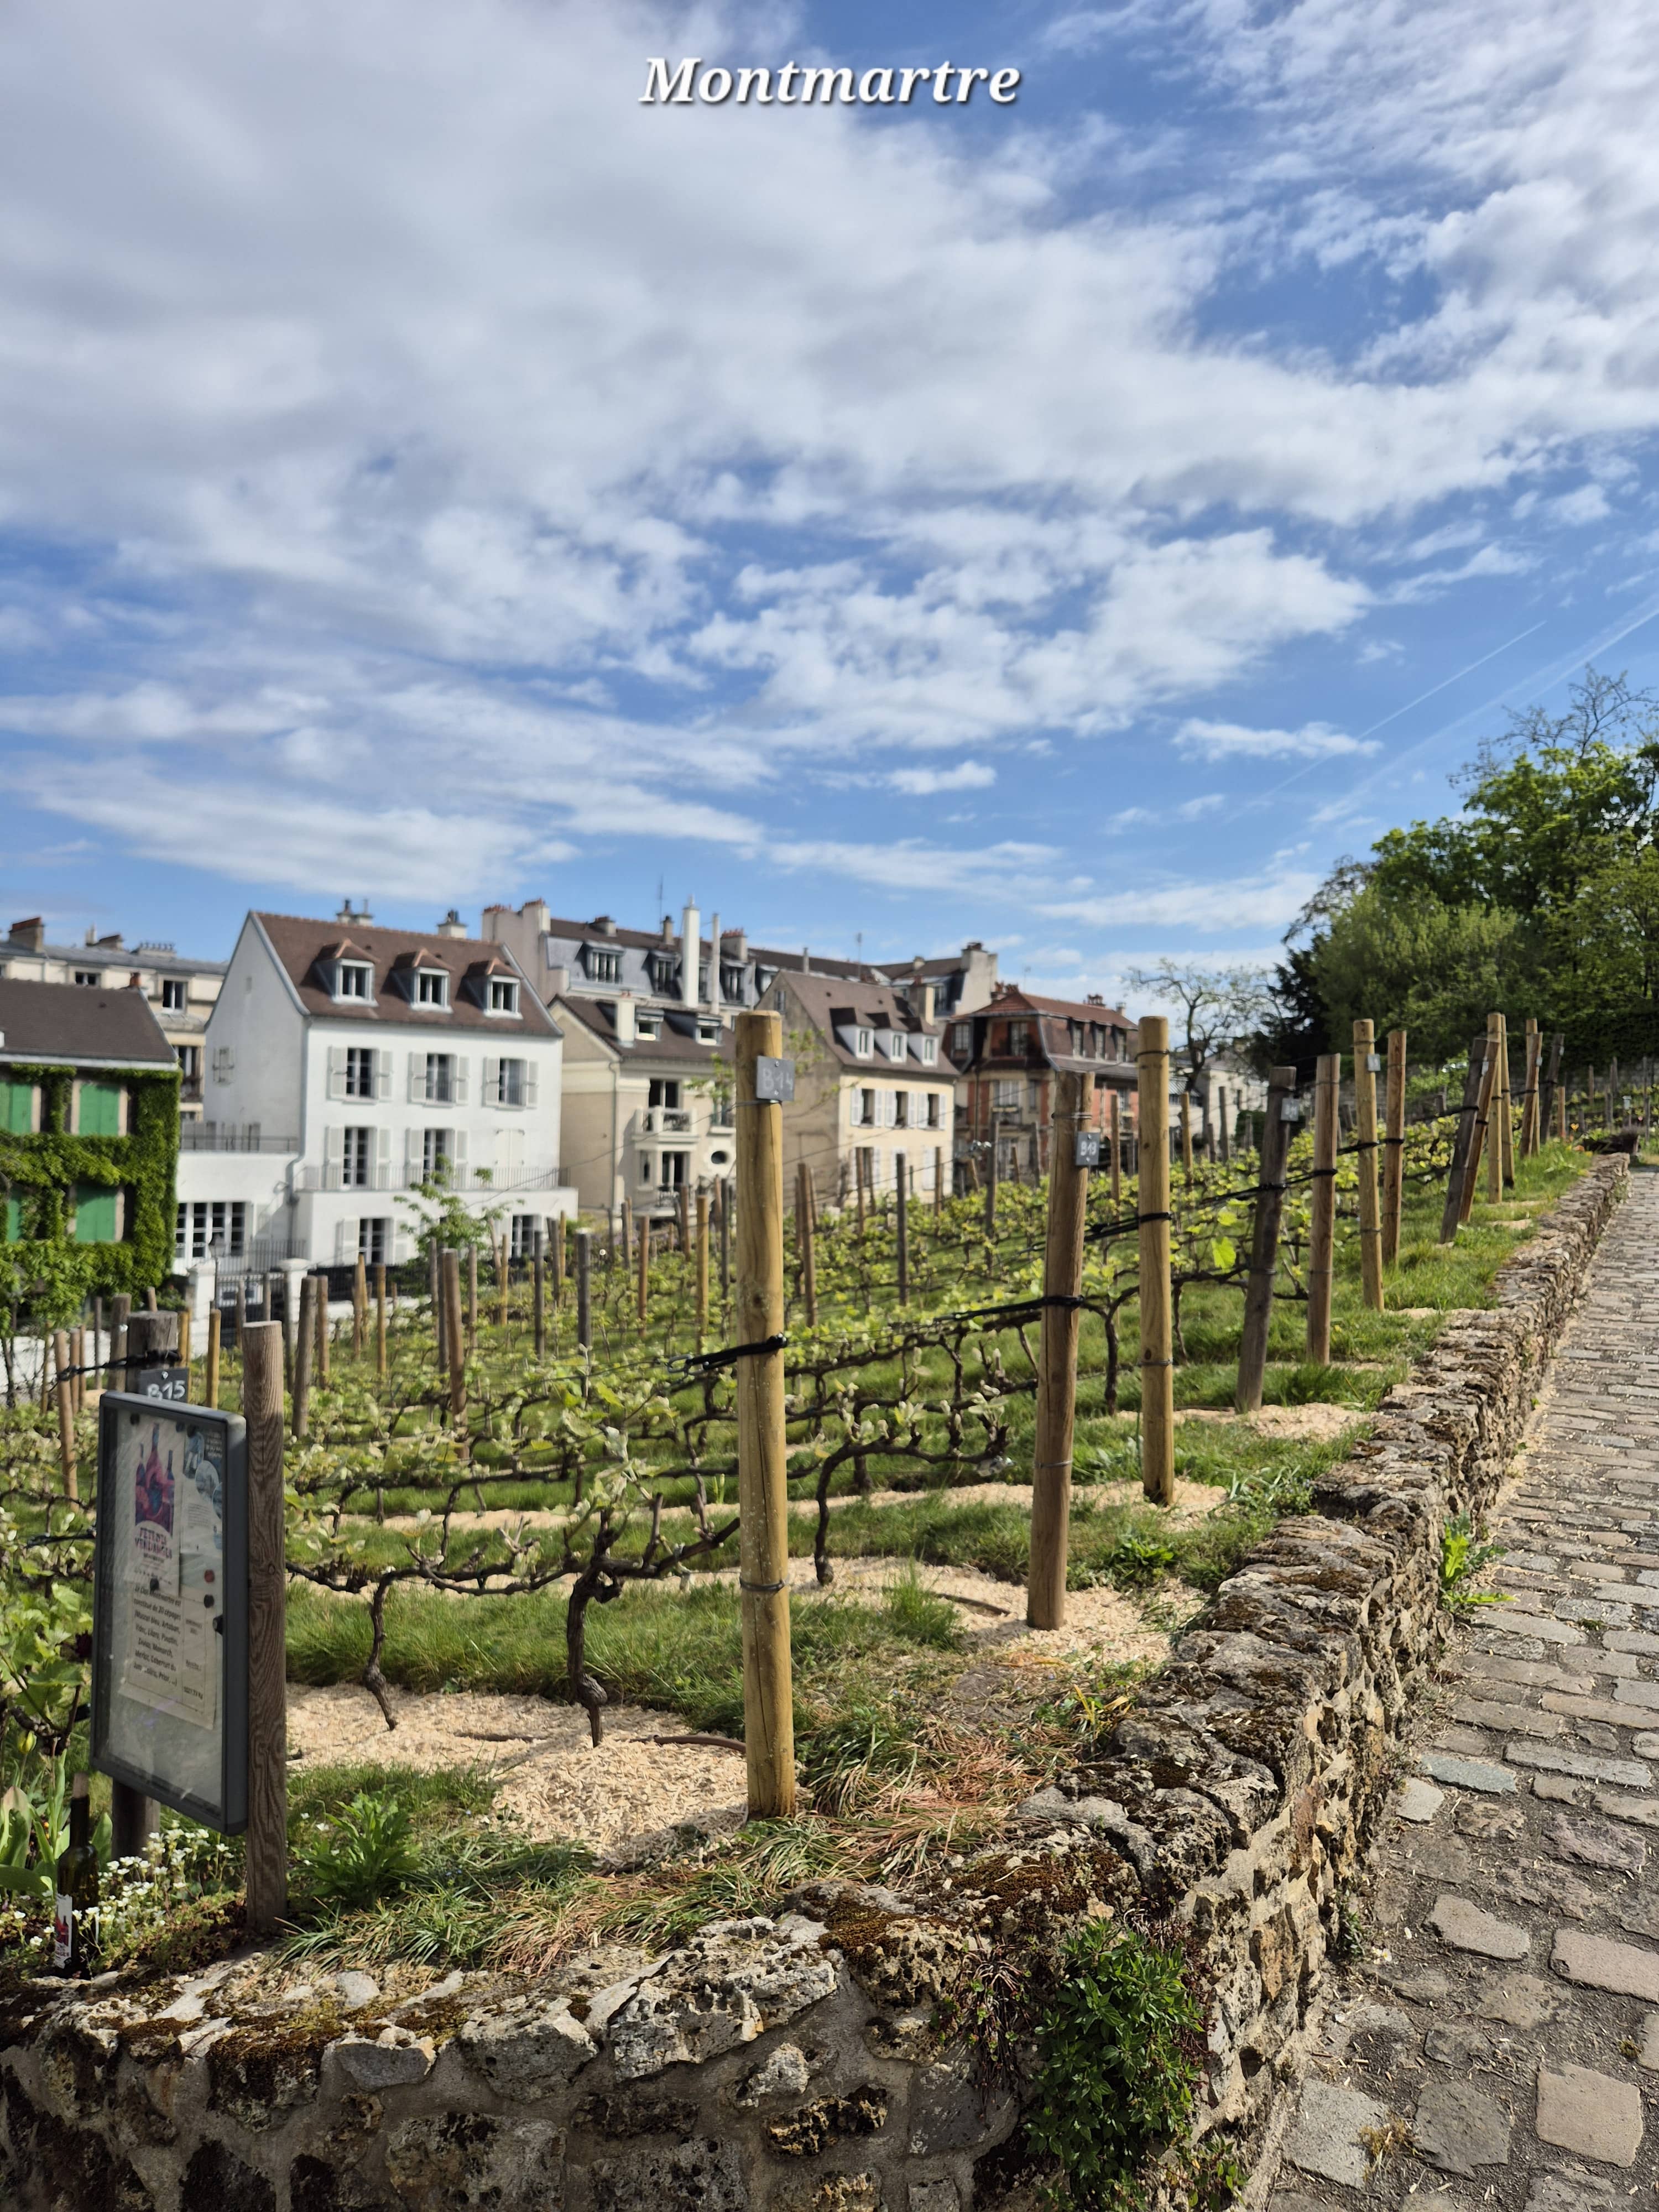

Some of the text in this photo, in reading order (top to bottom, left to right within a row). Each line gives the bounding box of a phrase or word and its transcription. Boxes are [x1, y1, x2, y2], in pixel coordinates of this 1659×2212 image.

[762, 1067, 793, 1091] B14
[1080, 1140, 1097, 1156] B13
[147, 1380, 186, 1401] B15
